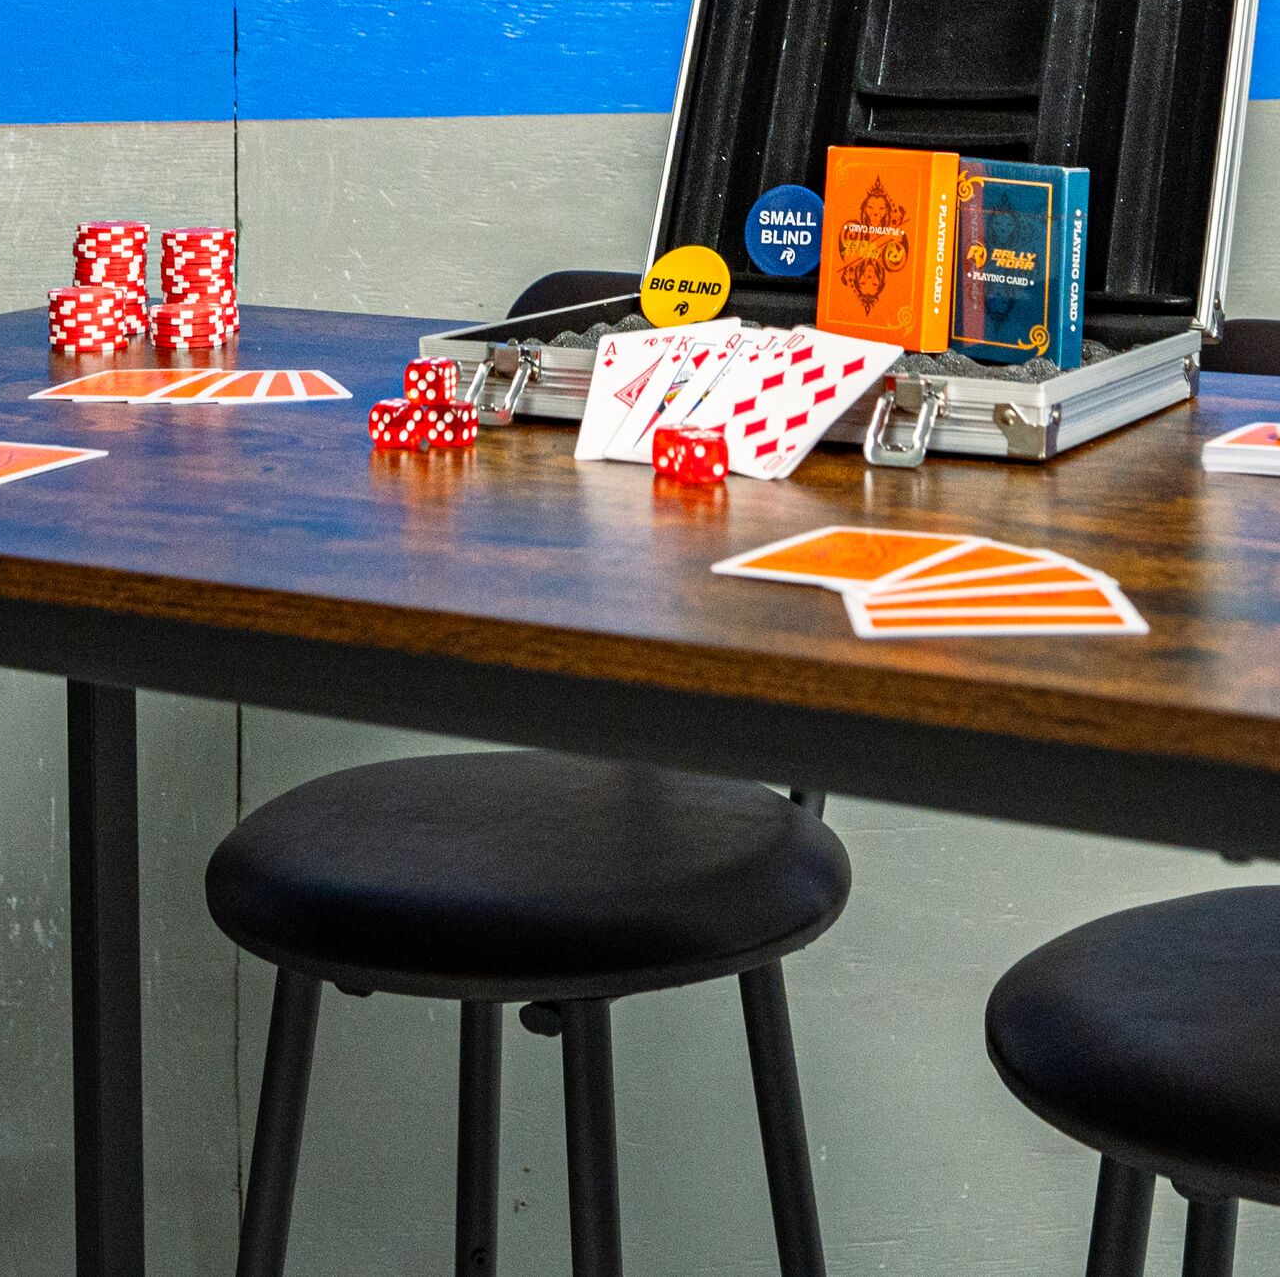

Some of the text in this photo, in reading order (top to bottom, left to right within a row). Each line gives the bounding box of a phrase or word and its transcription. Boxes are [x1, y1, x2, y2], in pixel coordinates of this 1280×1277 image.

[759, 210, 817, 227] SMALL
[761, 229, 812, 246] BLIND
[869, 226, 899, 236] PLAYING
[934, 204, 948, 304] PLAYING CARD
[1070, 219, 1083, 321] PLAYING CARD
[649, 277, 722, 296] BIG BLIND
[973, 272, 1029, 286] PLAYING CARD
[604, 341, 618, 356] A
[676, 336, 695, 352] K
